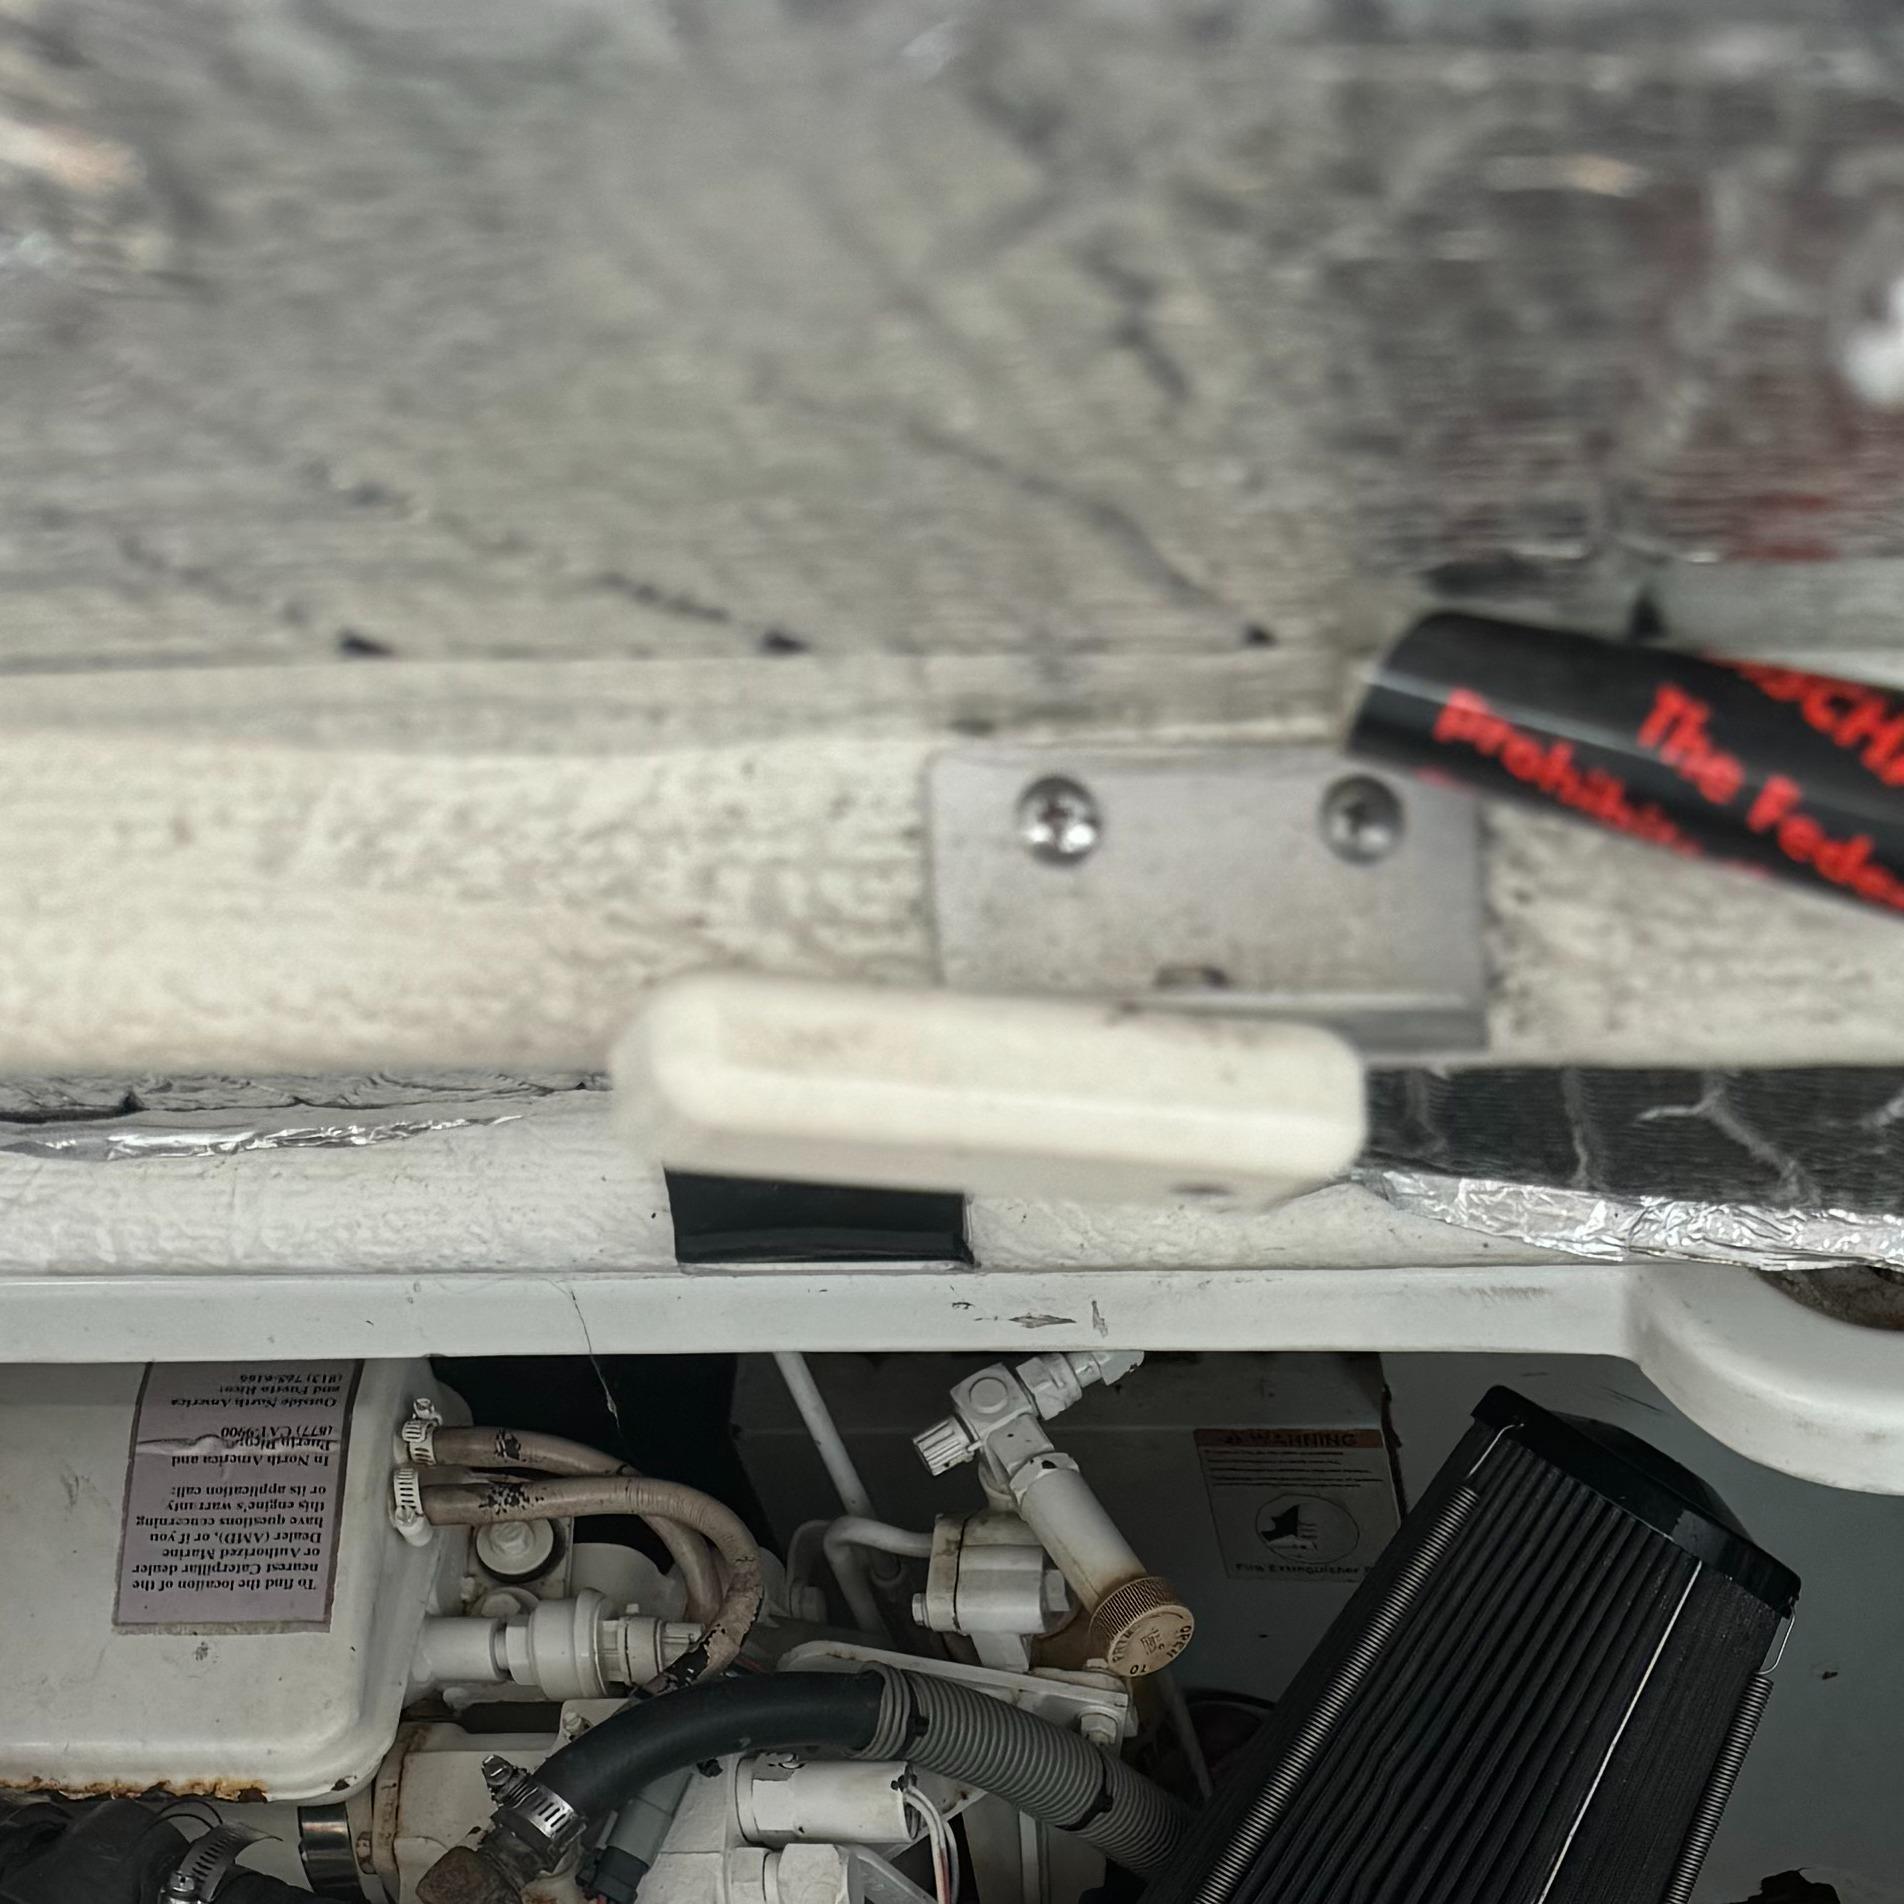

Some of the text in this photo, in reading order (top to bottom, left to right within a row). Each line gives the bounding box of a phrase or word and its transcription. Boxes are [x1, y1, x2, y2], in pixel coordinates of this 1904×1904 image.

[1638, 684, 1743, 803] The
[171, 1398, 337, 1407] Outside North America
[172, 1455, 329, 1466] In North America and
[172, 1484, 326, 1497] or its application call:
[167, 1499, 324, 1513] this engine's warranty
[136, 1515, 323, 1528] have questions concerning
[150, 1531, 321, 1544] Dealer (AMD), or if you
[162, 1549, 320, 1559] or Authorized Marine
[132, 1562, 318, 1575] nearest Caterpillar dealer
[132, 1578, 316, 1591] To find the location of the
